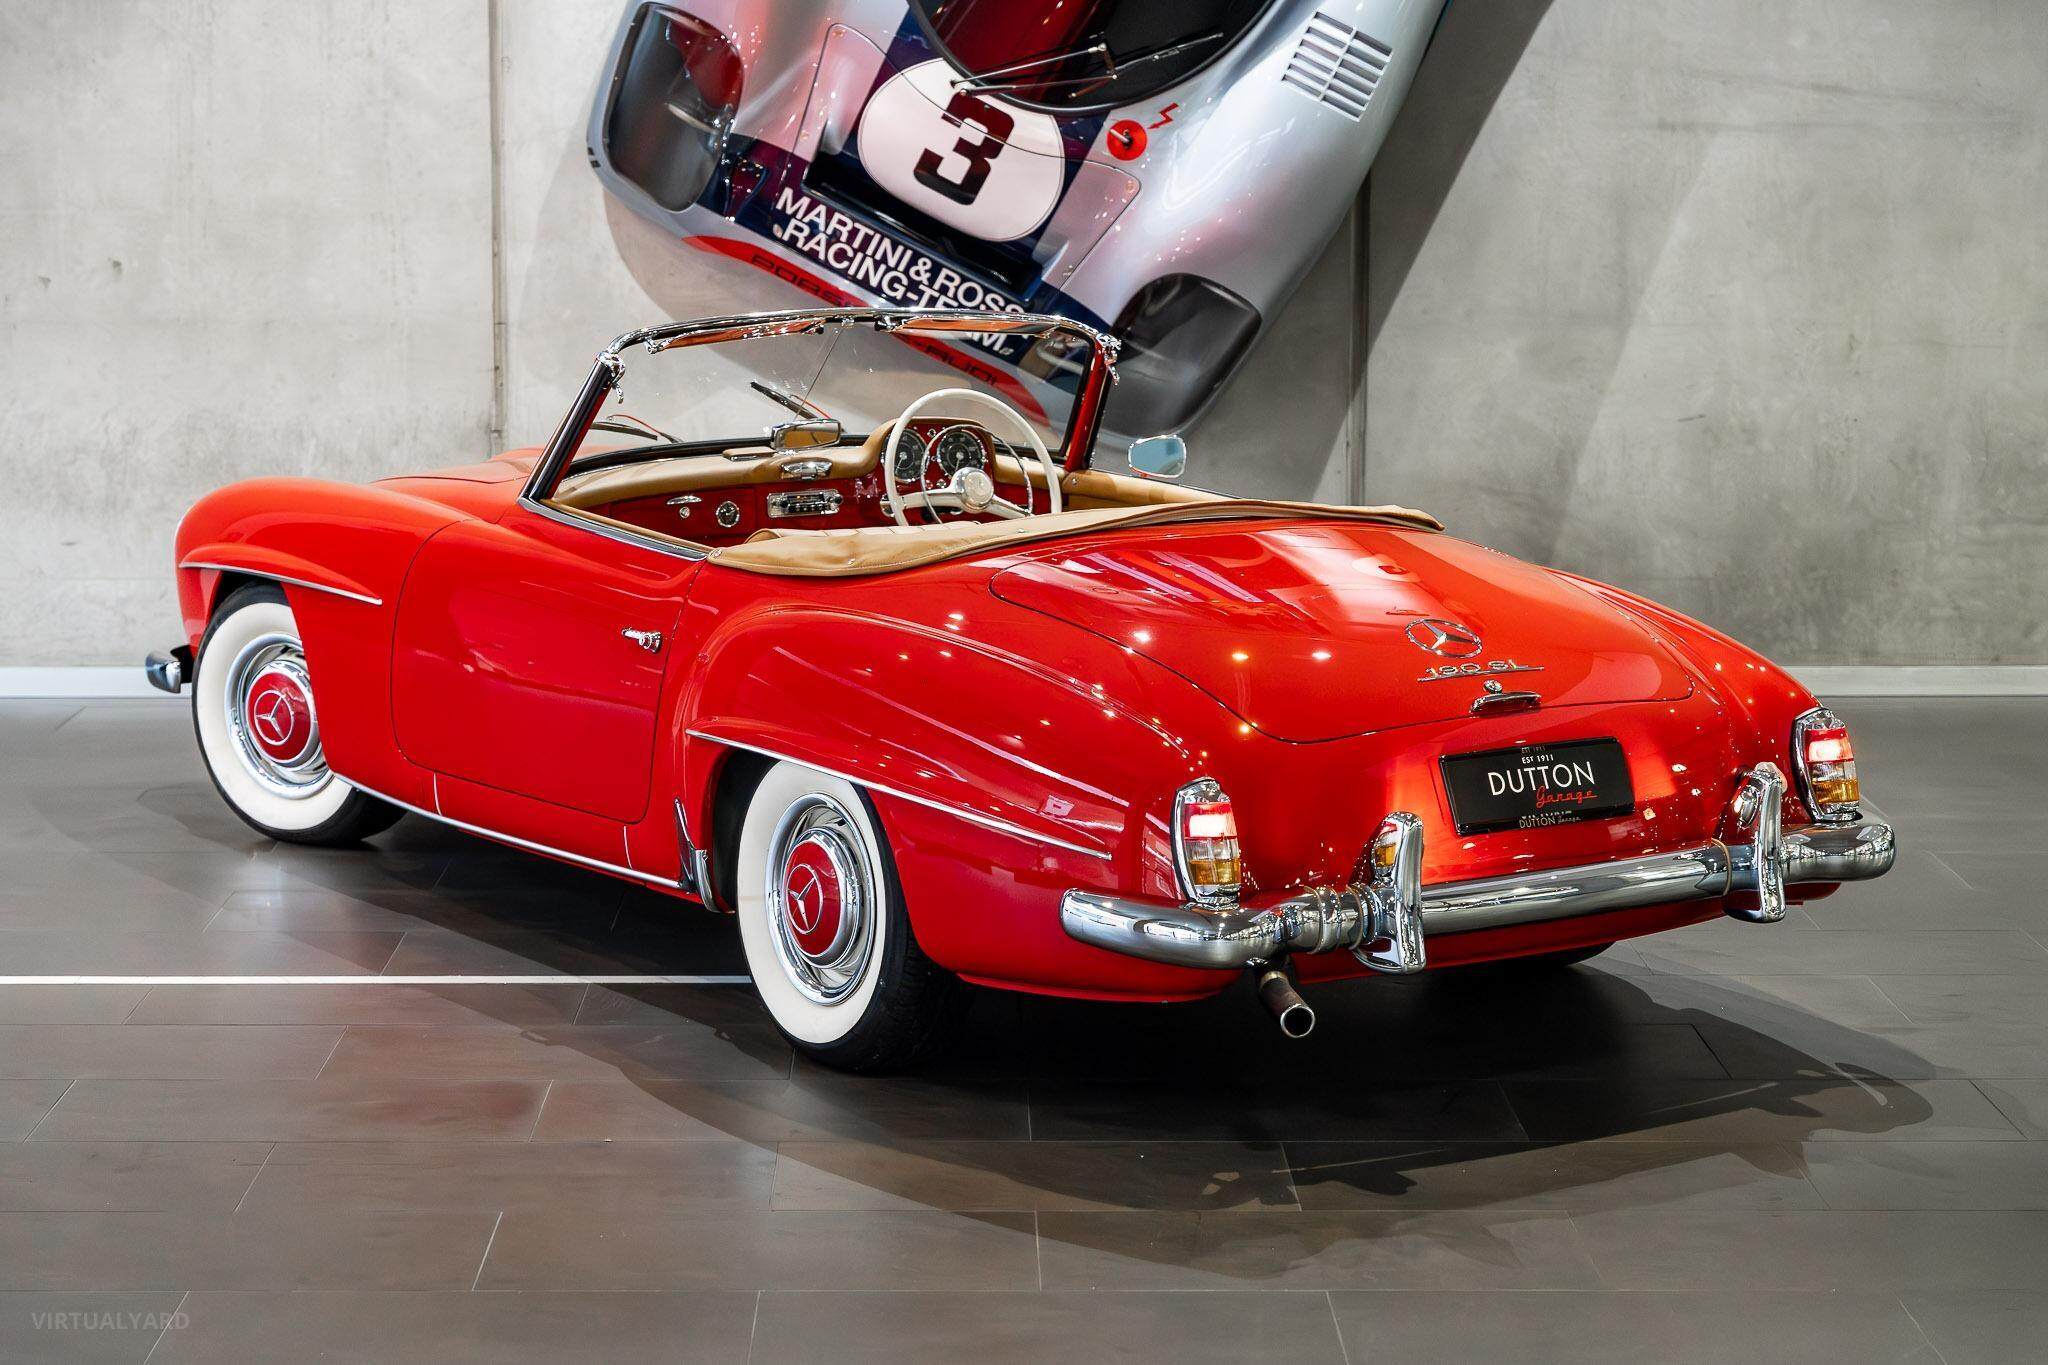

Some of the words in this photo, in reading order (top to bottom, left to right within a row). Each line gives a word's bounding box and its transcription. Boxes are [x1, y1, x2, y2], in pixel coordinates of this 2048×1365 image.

[913, 89, 1015, 206] 3
[775, 186, 914, 272] MARTINI
[908, 257, 933, 285] &
[1522, 755, 1534, 764] EST
[1537, 754, 1554, 763] 1911
[1487, 761, 1595, 796] DUTTON
[1535, 785, 1598, 809] Garage
[1519, 816, 1556, 829] DUTTON
